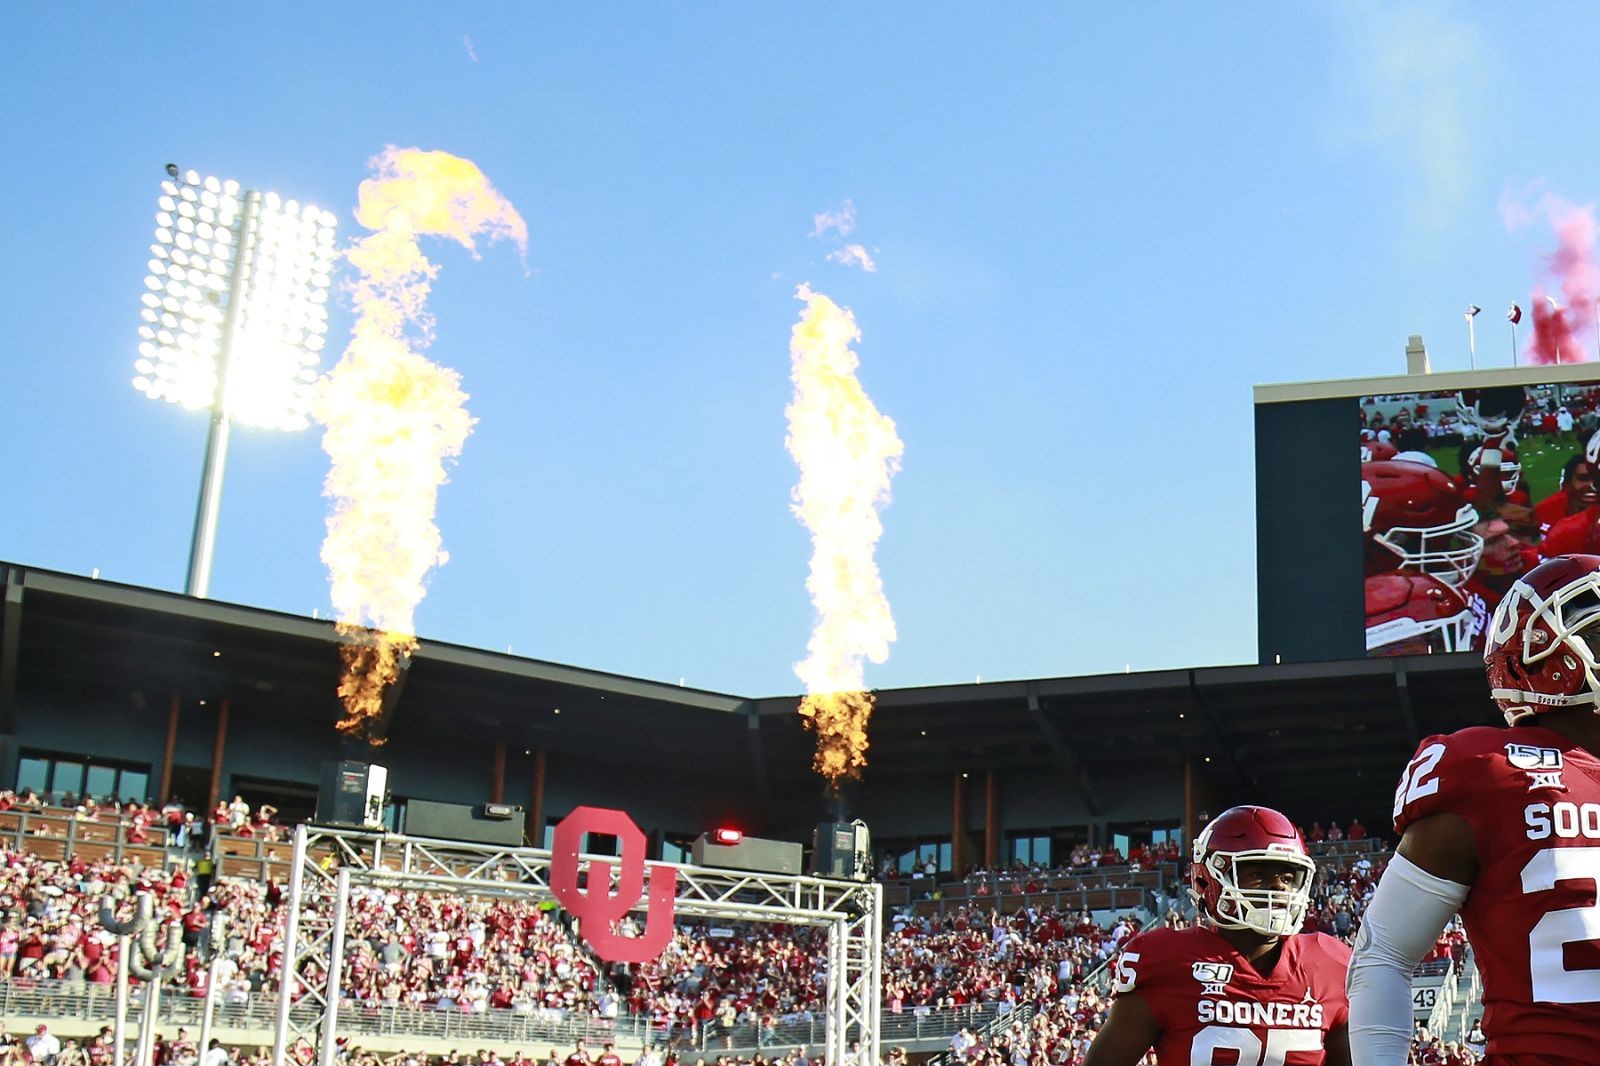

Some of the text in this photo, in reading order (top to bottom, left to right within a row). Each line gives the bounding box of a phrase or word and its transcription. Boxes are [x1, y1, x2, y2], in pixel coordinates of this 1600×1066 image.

[1505, 743, 1563, 770] 150
[550, 805, 676, 963] OU
[1192, 961, 1233, 985] 150
[1413, 989, 1436, 1007] 43
[1198, 1000, 1323, 1027] SOONERS
